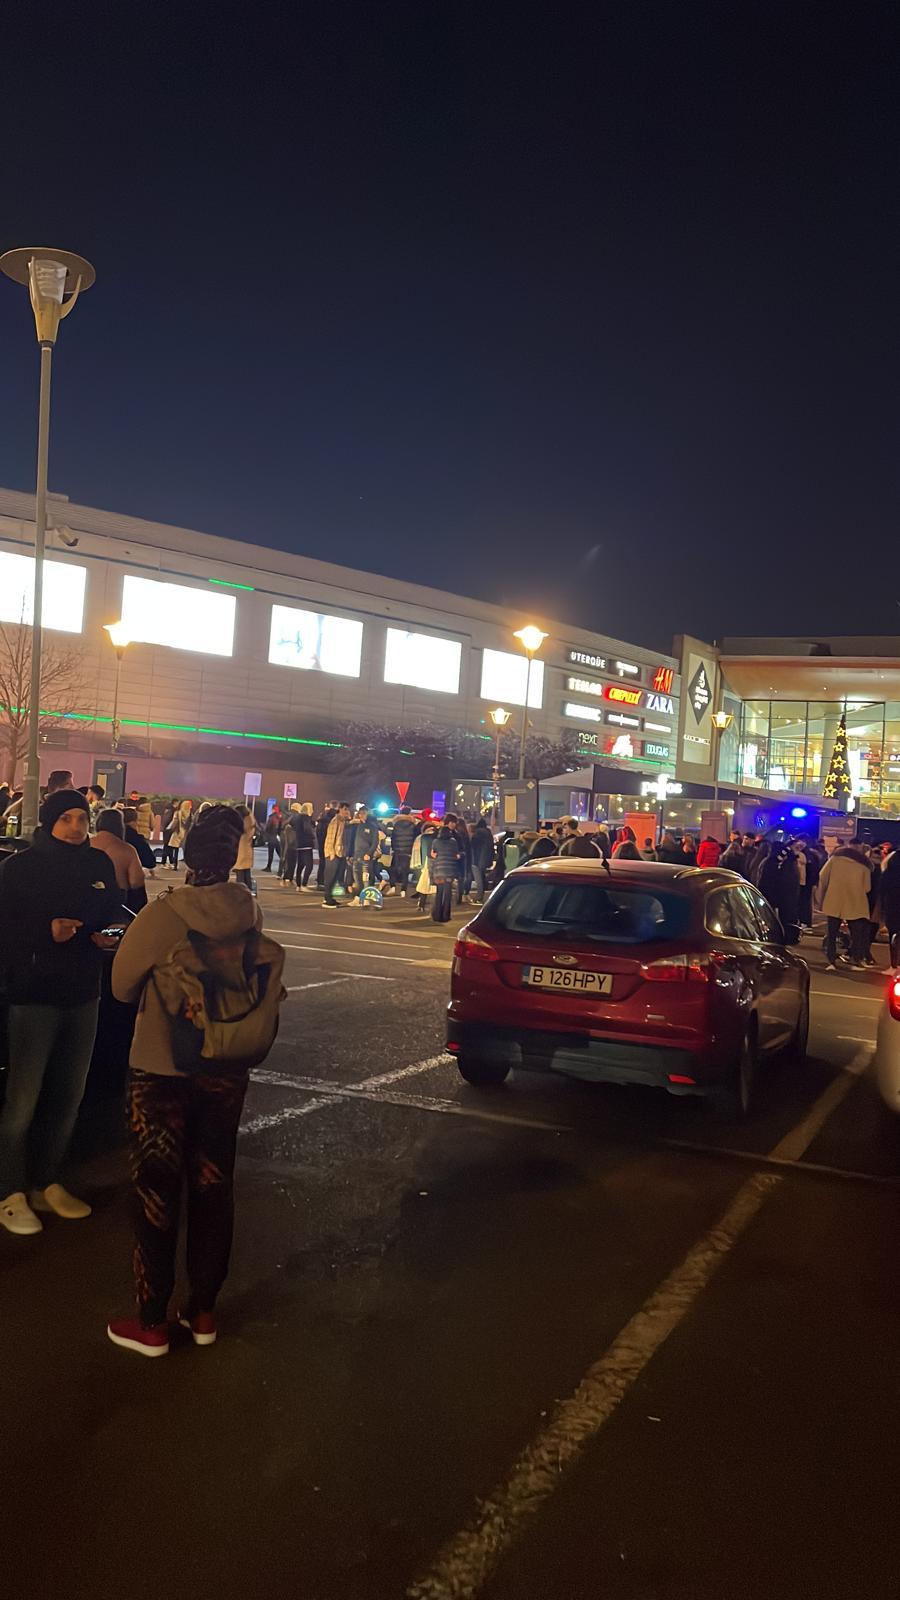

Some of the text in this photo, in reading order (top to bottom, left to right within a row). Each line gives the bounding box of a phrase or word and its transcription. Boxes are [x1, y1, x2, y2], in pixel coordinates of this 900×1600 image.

[570, 651, 606, 669] UTERQÜE
[646, 693, 674, 714] ZARA
[578, 732, 598, 746] next
[533, 968, 544, 983] B
